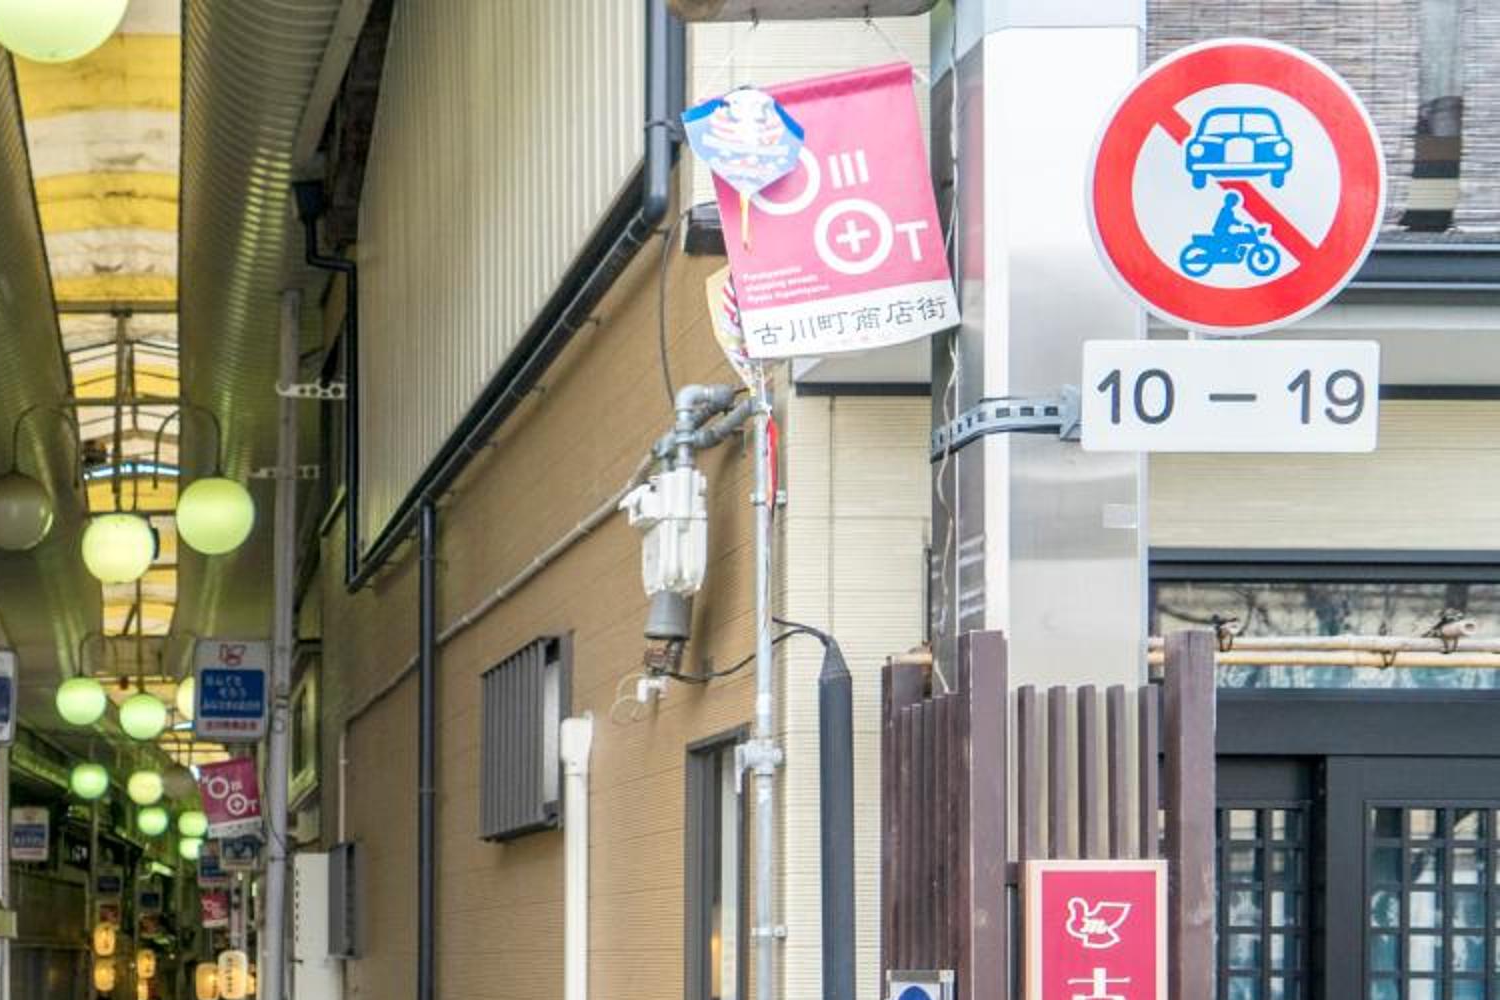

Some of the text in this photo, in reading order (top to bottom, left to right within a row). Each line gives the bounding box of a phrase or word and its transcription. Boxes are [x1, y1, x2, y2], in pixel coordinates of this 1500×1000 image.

[753, 296, 947, 346] 古川町商店街
[1097, 368, 1174, 425] 10
[1287, 369, 1365, 425] 19
